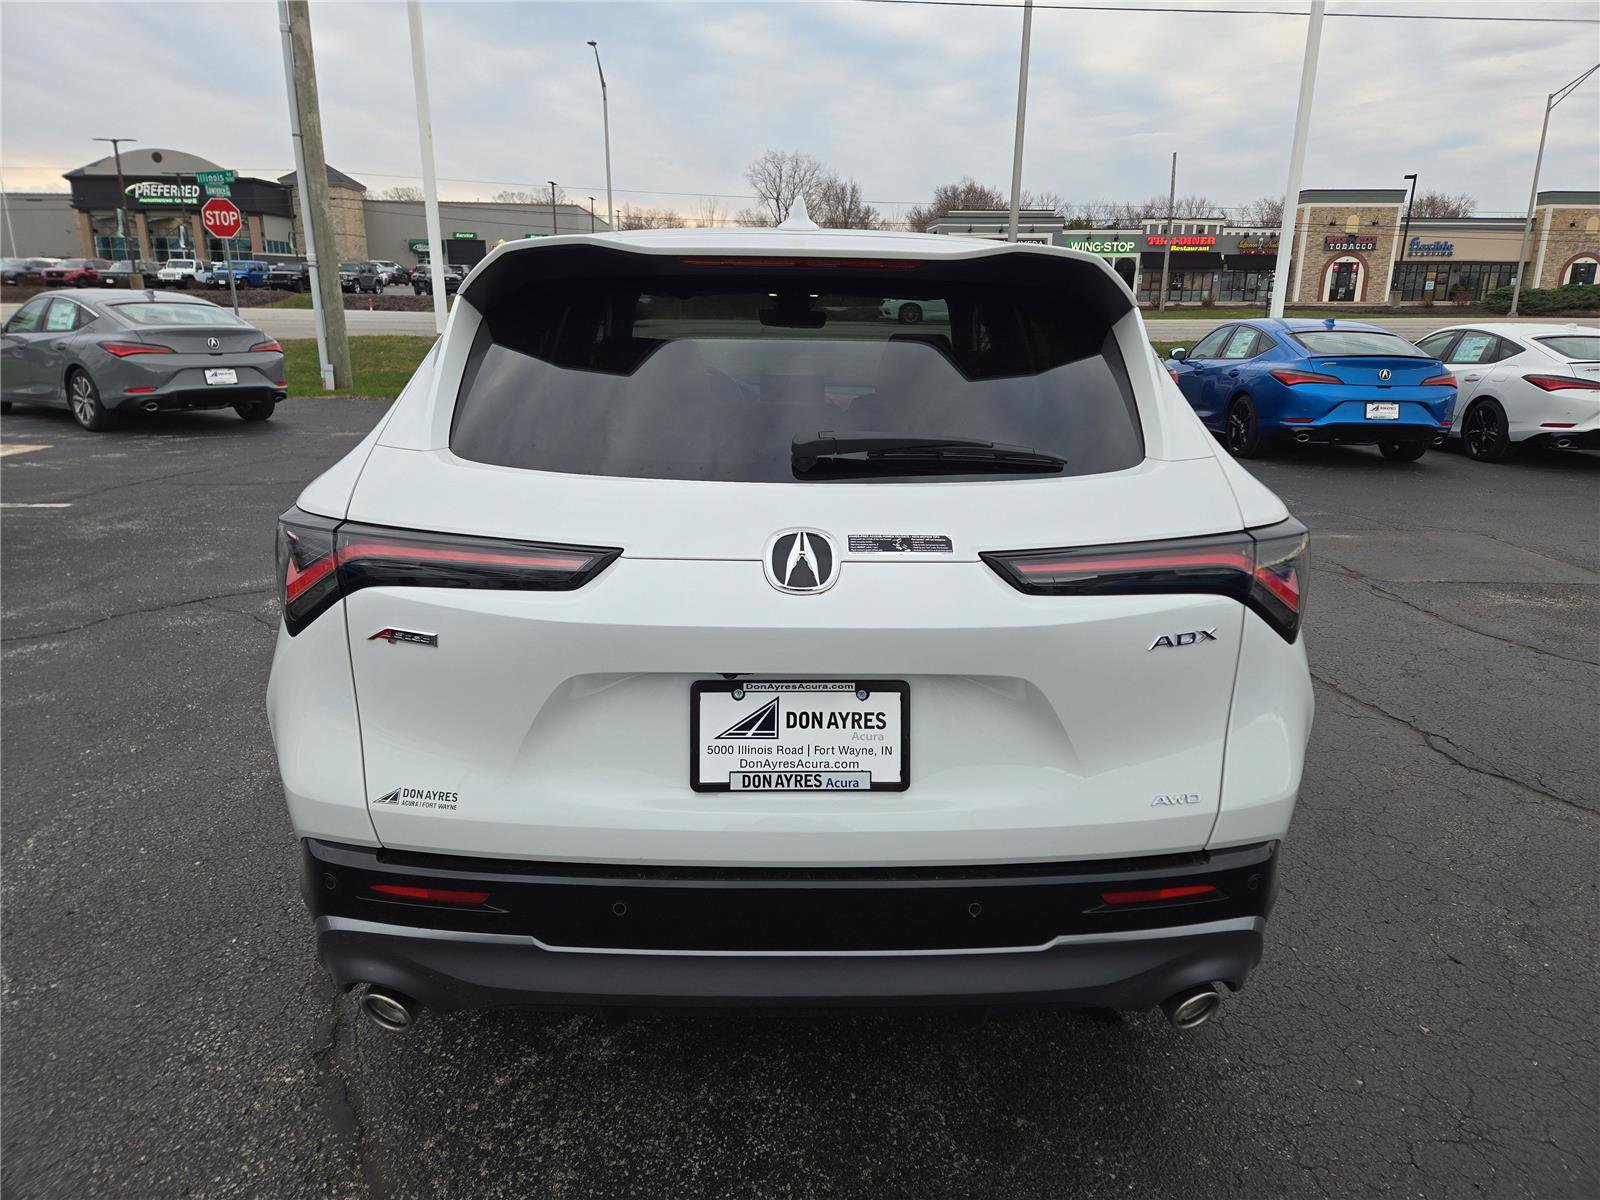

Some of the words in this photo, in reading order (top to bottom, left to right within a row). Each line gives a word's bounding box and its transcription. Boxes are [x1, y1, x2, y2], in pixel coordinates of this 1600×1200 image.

[196, 172, 224, 182] Illinois
[135, 183, 200, 198] PREFERRED
[206, 210, 238, 225] STOP
[1148, 627, 1217, 650] ADX
[746, 683, 853, 691] DonAyresAcura.com
[786, 712, 823, 729] DON
[827, 712, 886, 729] AYRES
[851, 732, 884, 741] Acura
[707, 745, 734, 755] 5000
[738, 745, 773, 755] Illinois
[777, 745, 803, 755] Road
[814, 745, 835, 755] Fort
[837, 745, 877, 757] Wayne,
[881, 746, 892, 755] IN
[739, 759, 859, 770] DonAyresAcura.com
[742, 774, 772, 788] DON
[775, 774, 822, 788] AYRES
[826, 777, 859, 788] Acura
[403, 788, 423, 799] DON
[425, 790, 458, 802] AYRES
[1151, 793, 1200, 806] AWD
